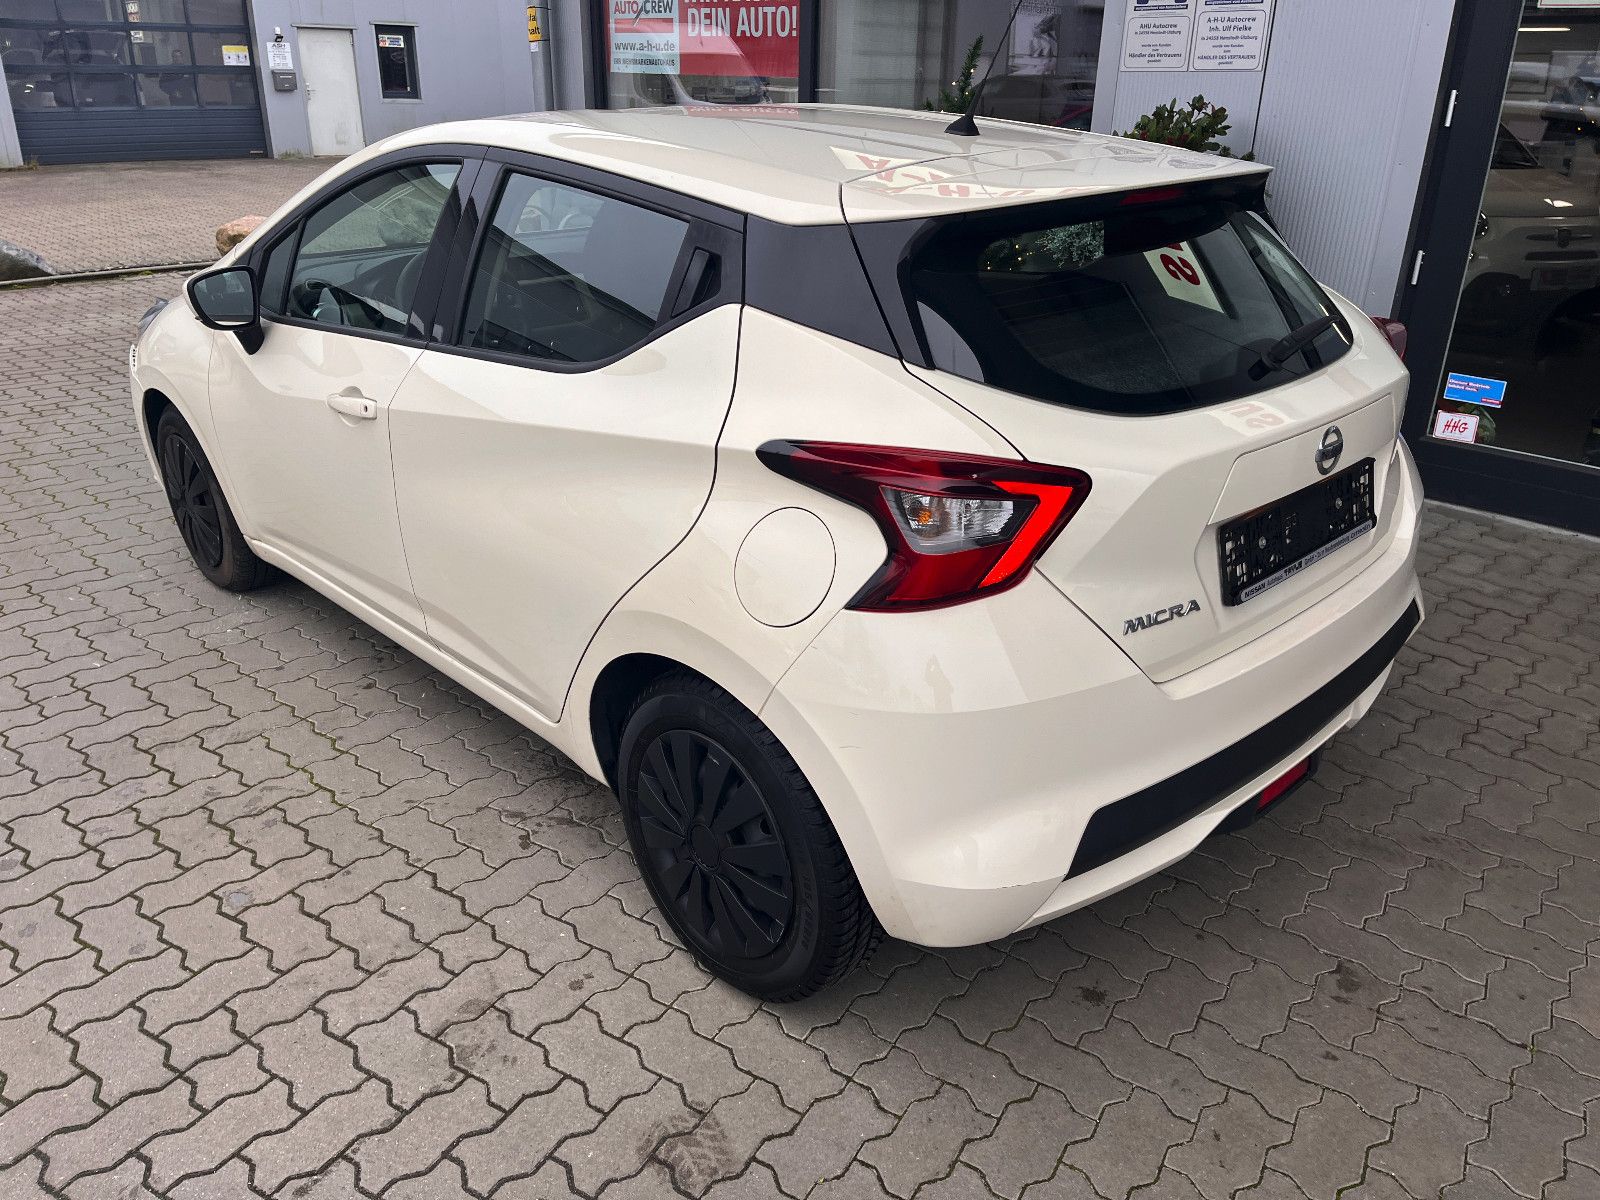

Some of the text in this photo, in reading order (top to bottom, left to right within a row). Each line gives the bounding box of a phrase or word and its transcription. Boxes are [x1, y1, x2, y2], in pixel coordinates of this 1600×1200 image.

[614, 0, 673, 15] AUTO CREW
[687, 5, 797, 37] DEIN AUTO!
[1207, 16, 1226, 24] A-H-U
[614, 40, 675, 52] www.a-h-u.de
[1442, 418, 1469, 434] HHG
[1244, 582, 1266, 599] NISSAN
[1123, 599, 1201, 636] MICRA
